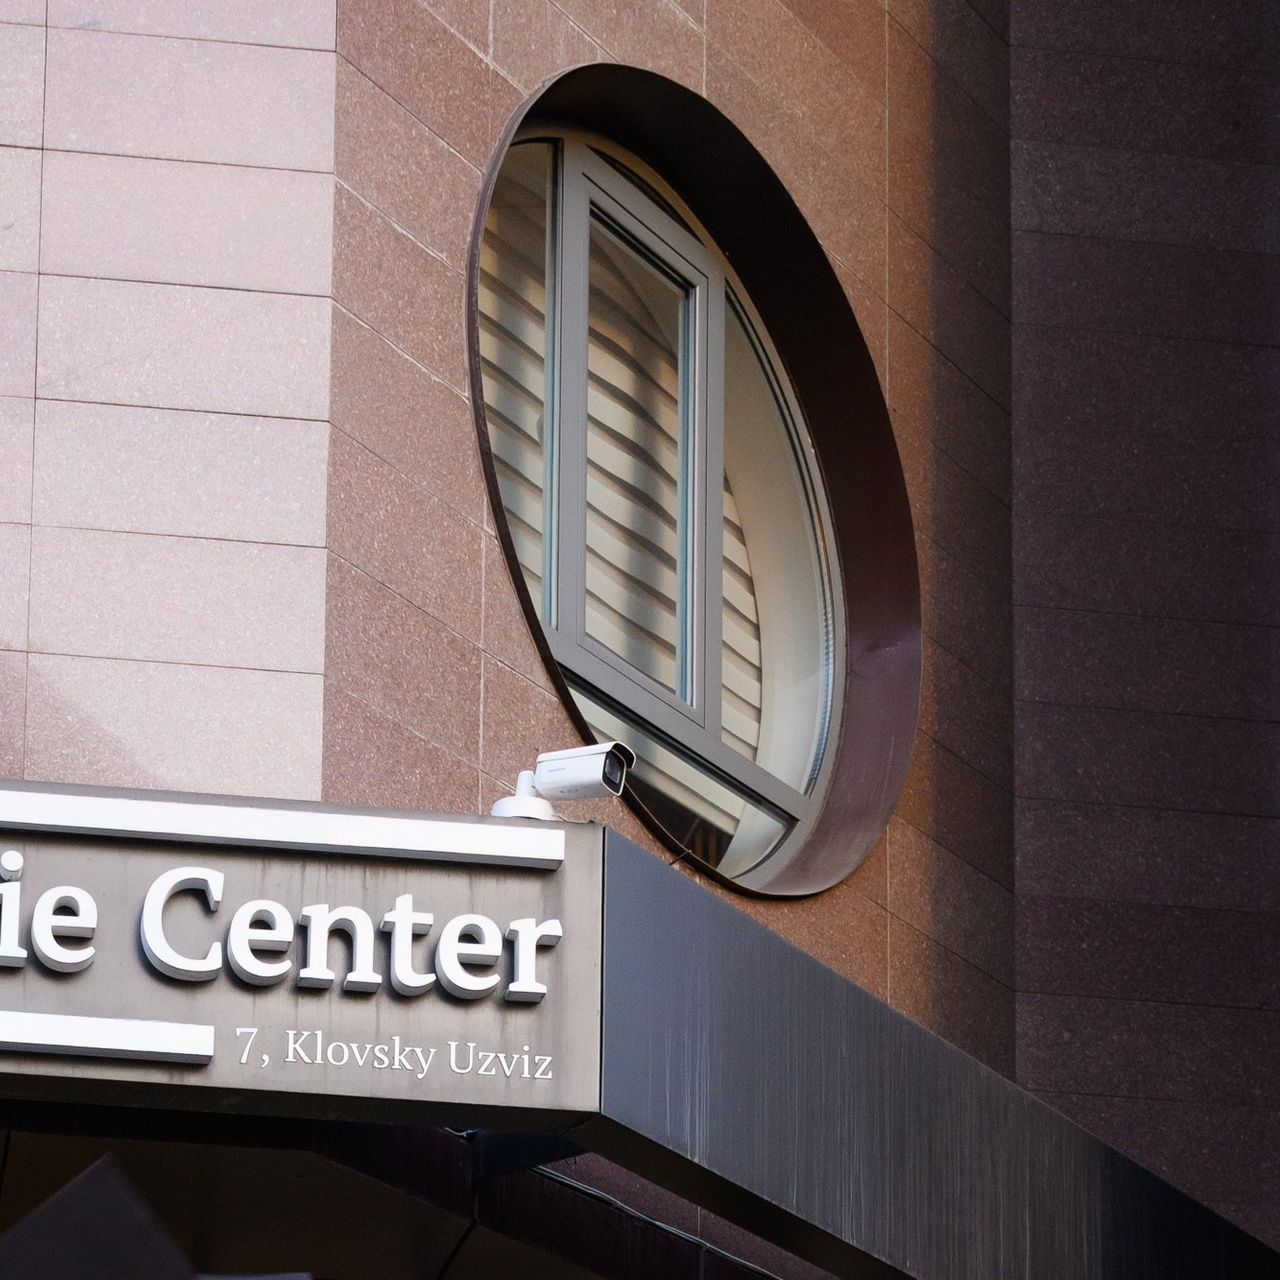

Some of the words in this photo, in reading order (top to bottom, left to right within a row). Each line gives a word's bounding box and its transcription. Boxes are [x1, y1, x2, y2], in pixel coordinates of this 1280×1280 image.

[140, 866, 564, 1003] Center
[235, 1027, 270, 1068] 7,
[284, 1030, 437, 1079] Klovsky
[447, 1041, 554, 1080] Uzviz
